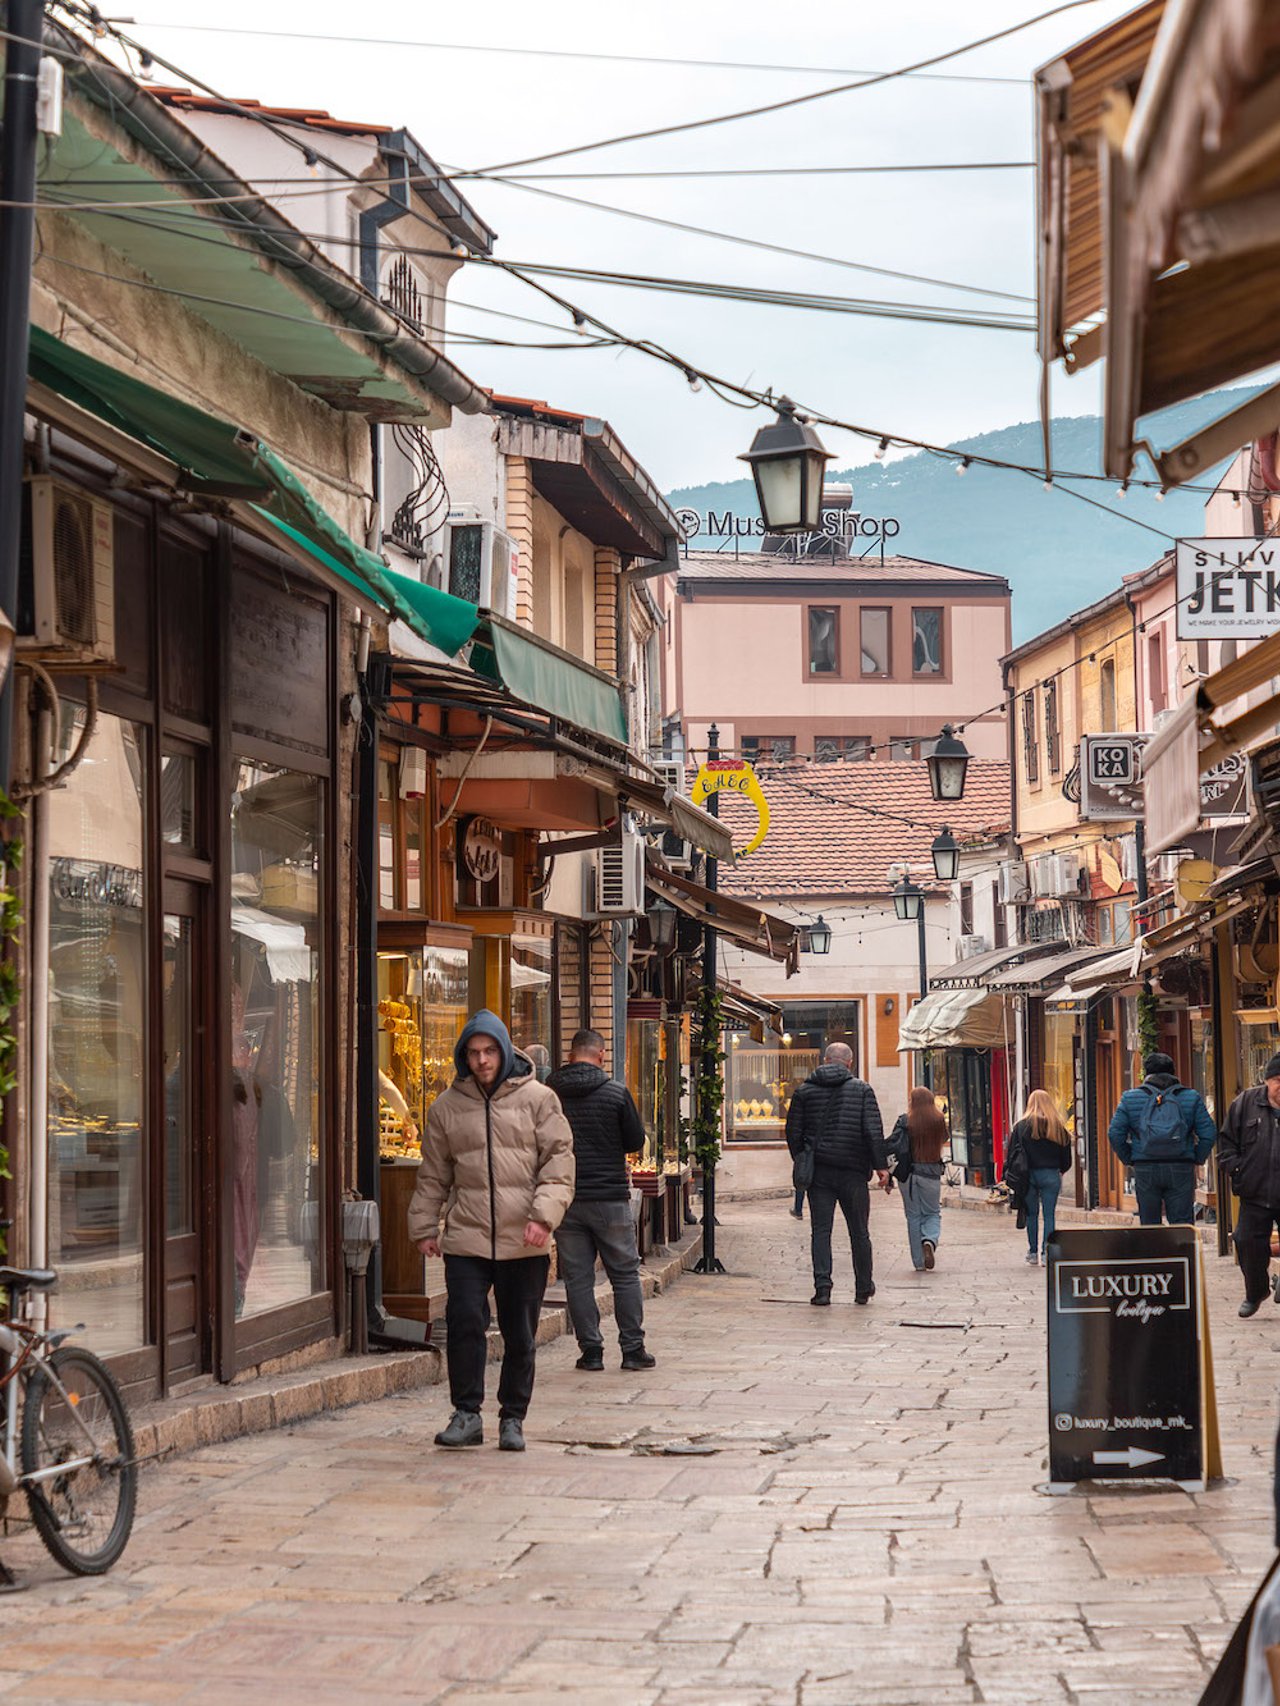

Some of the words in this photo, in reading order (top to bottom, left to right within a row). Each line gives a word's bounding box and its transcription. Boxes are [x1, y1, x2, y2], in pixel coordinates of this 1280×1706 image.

[708, 511, 766, 536] Mus
[823, 510, 900, 542] Shop
[1072, 1274, 1173, 1297] LUXURY
[1116, 1299, 1166, 1324] boutique
[1074, 1415, 1193, 1431] luxury_boutique_mk_
